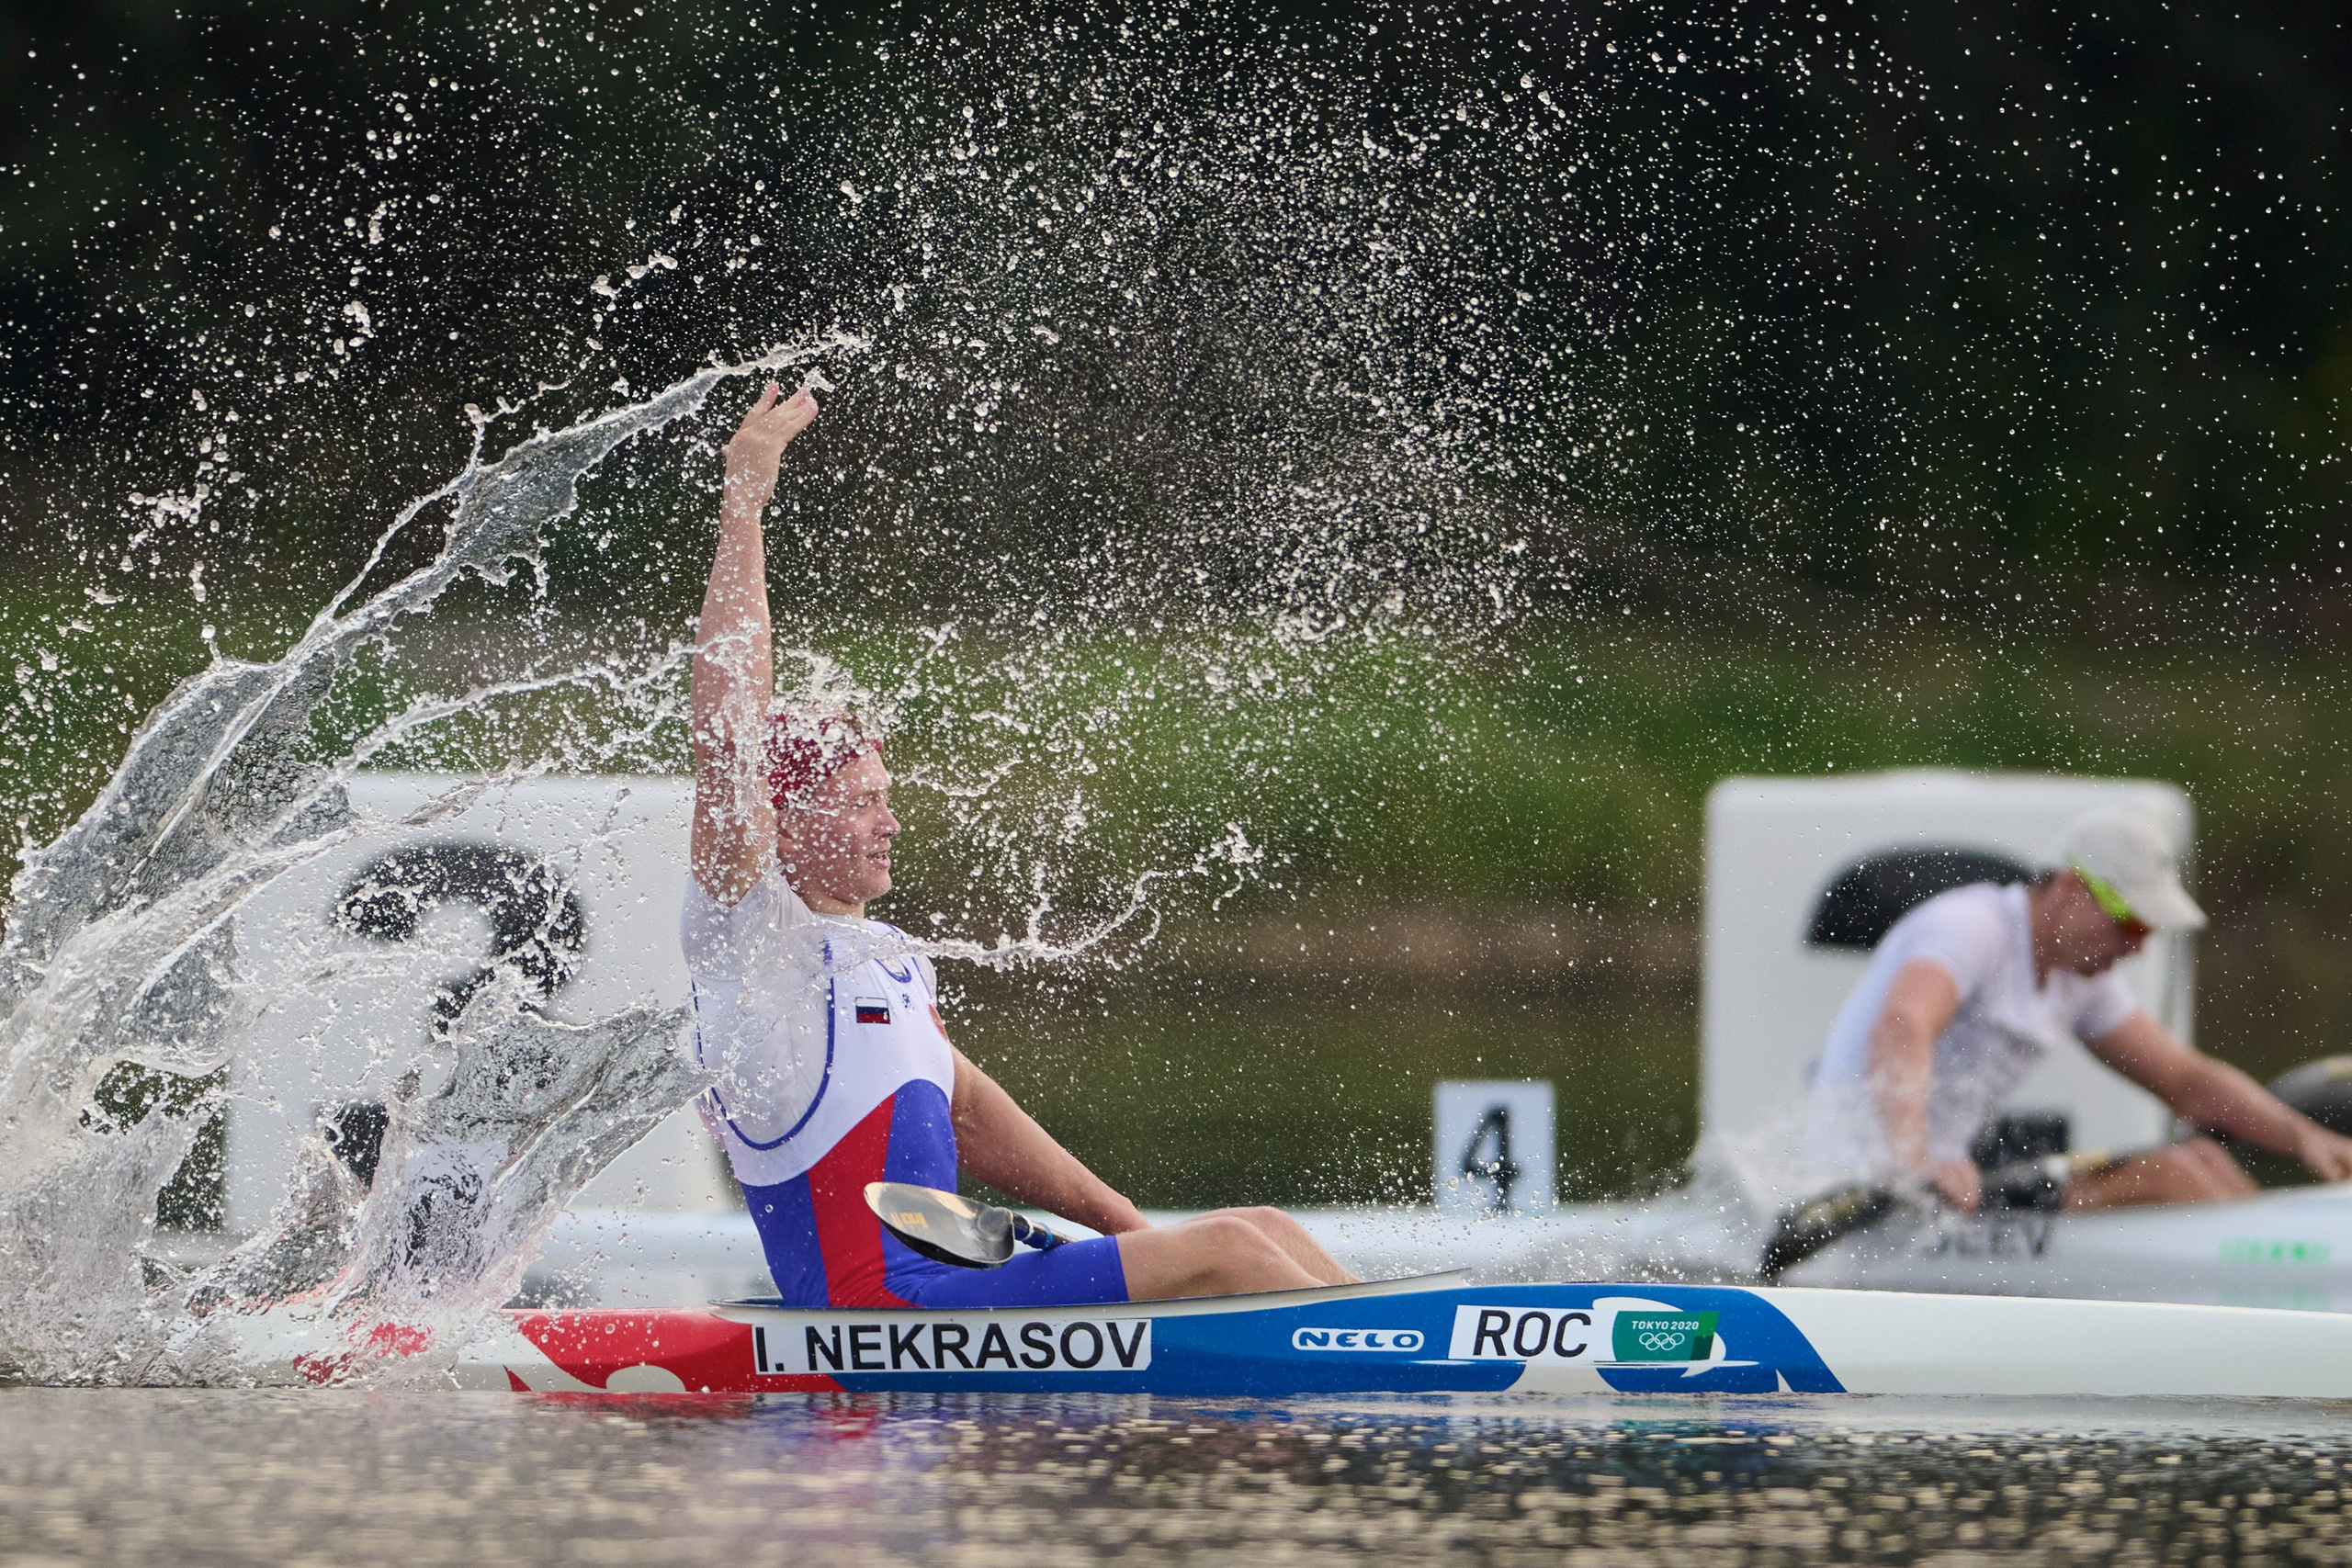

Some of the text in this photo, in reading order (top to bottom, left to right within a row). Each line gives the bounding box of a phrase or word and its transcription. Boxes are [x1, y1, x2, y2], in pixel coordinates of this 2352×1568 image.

[1460, 1106, 1521, 1214] 4
[755, 1321, 1148, 1372] I. NEKRASOV
[1298, 1331, 1419, 1348] NELO
[1473, 1309, 1591, 1358] ROC
[1632, 1321, 1699, 1330] TOKYO 2020
